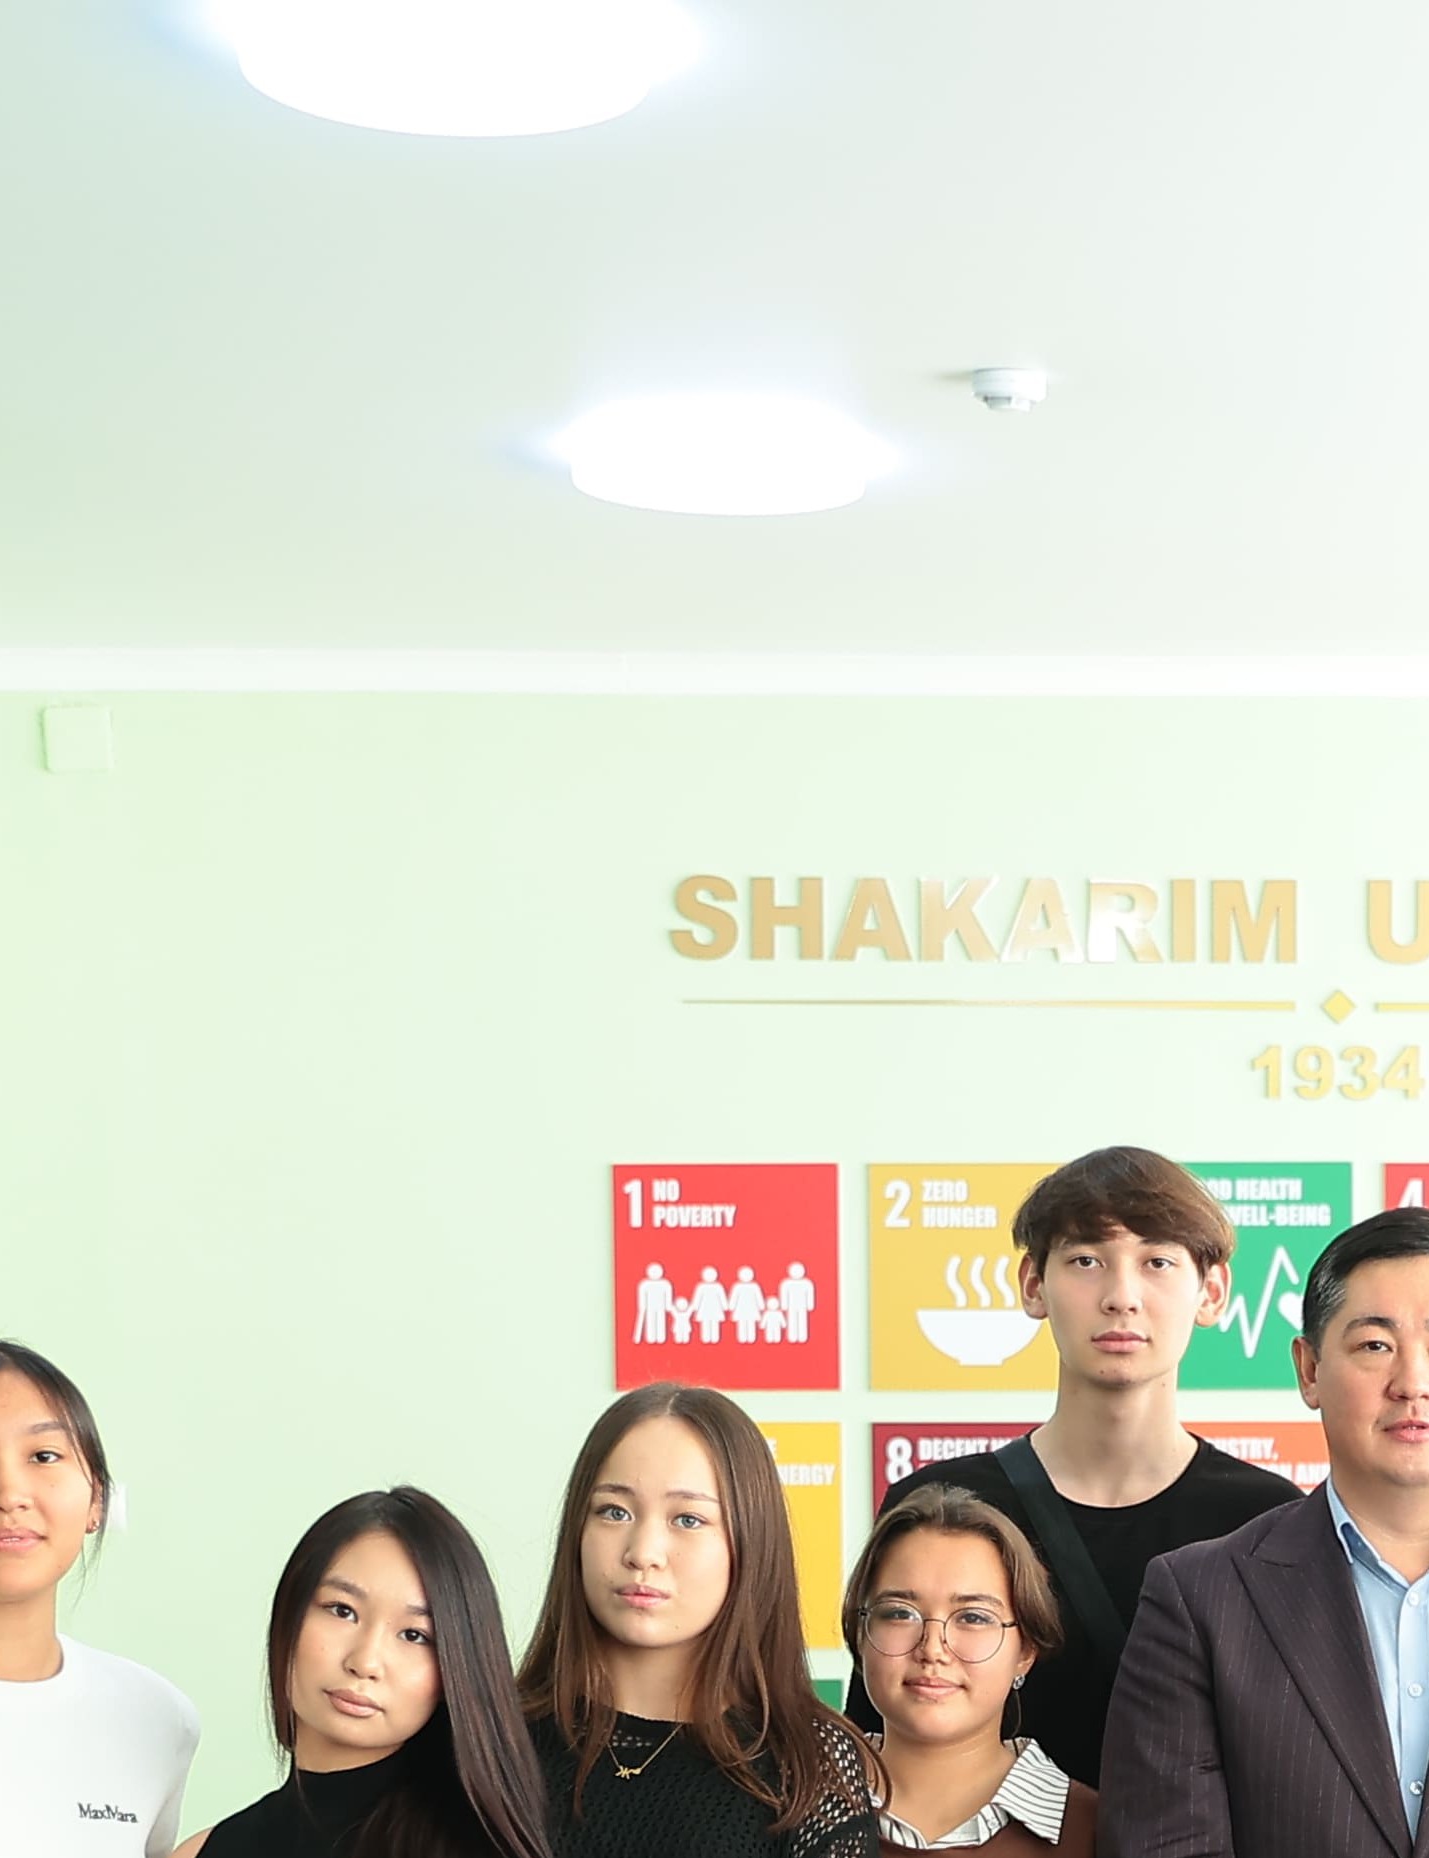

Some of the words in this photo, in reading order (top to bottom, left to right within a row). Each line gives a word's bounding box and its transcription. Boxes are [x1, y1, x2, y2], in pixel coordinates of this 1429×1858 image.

[668, 874, 1297, 964] SHAKARIM
[1250, 1044, 1426, 1101] 1934
[651, 1179, 681, 1202] NO
[921, 1180, 969, 1202] ZERO
[1206, 1178, 1233, 1201] OD
[1235, 1178, 1303, 1201] HEALTH
[623, 1179, 644, 1229] 1
[884, 1179, 912, 1229] 2
[651, 1204, 737, 1229] POVERTY
[921, 1205, 999, 1229] HUNGER
[885, 1436, 914, 1484] 8
[917, 1437, 989, 1461] DECENT
[776, 1464, 836, 1487] NERGY
